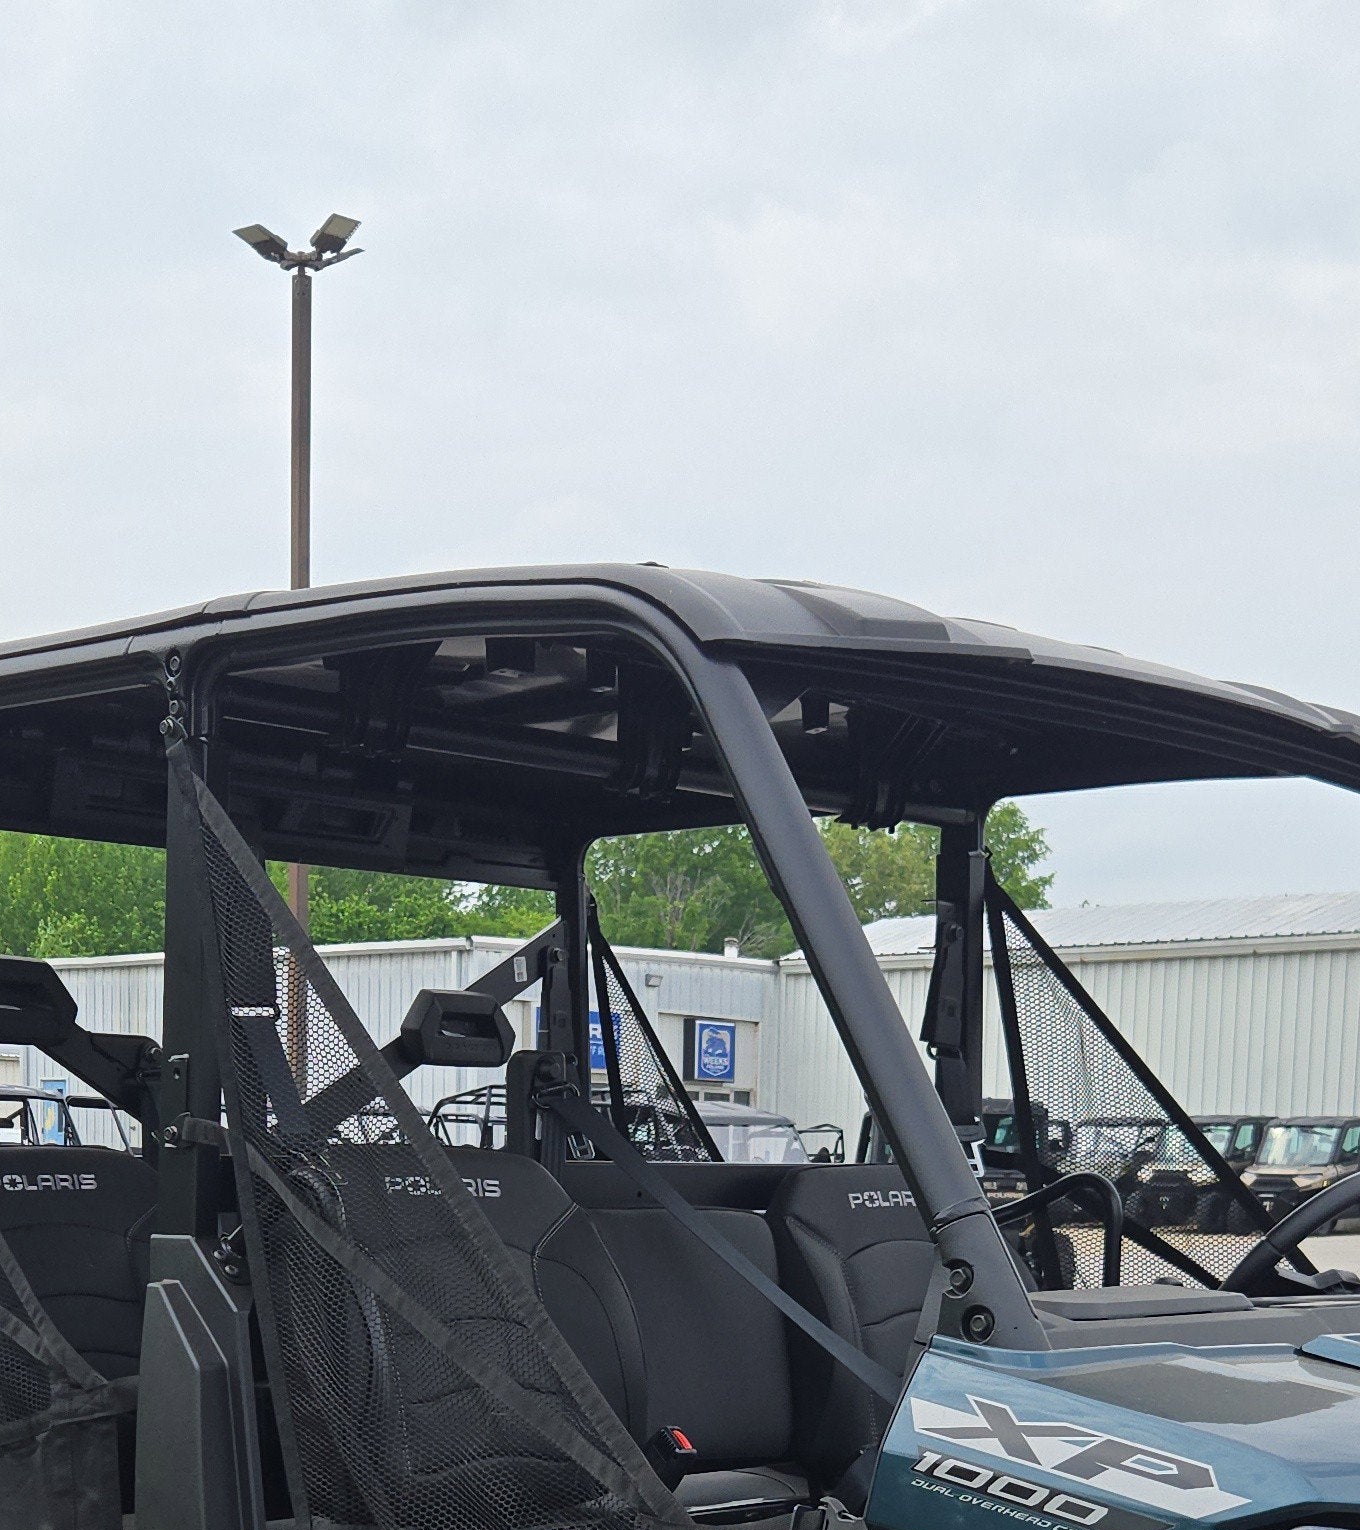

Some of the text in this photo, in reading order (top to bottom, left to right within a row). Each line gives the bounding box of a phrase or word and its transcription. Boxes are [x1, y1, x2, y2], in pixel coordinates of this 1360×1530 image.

[384, 1176, 502, 1198] POLRIS
[847, 1189, 918, 1210] POLAR
[917, 1394, 1220, 1492] XP
[910, 1478, 955, 1499] DUAL
[958, 1493, 1052, 1529] OVERHEAD
[911, 1450, 1110, 1526] 1000
